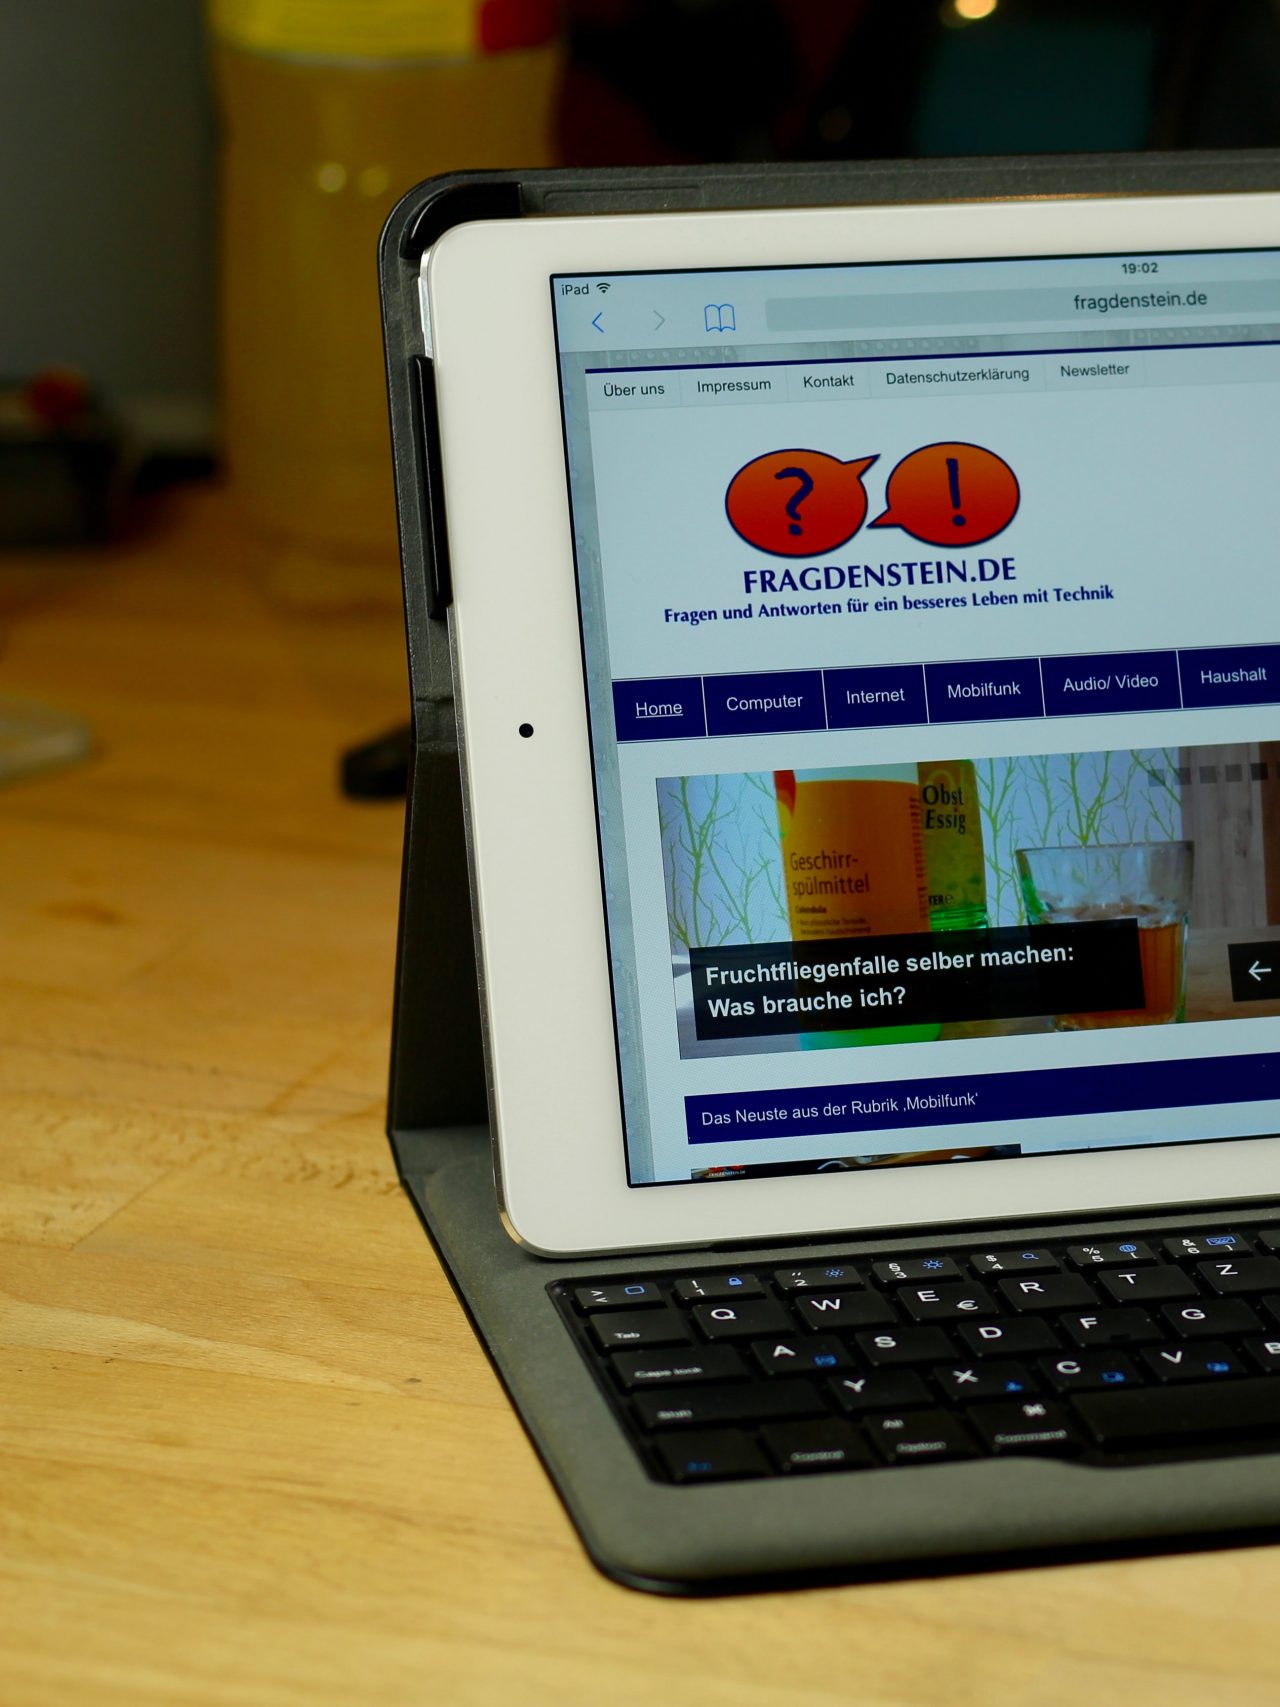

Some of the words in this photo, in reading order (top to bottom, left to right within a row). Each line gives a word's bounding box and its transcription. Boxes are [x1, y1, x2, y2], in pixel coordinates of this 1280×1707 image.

[1122, 263, 1158, 274] 19:02
[561, 283, 589, 296] iPad
[1074, 291, 1208, 313] fragdenstein.de
[885, 366, 1030, 386] Datenschutzerklärung
[1060, 364, 1130, 377] Newsletter
[697, 378, 772, 396] Impressum
[803, 374, 855, 388] Kontakt
[603, 382, 635, 397] Über
[640, 384, 665, 396] uns
[743, 557, 1017, 594] FRAGDENSTEIN.DE
[664, 606, 718, 626] Fragen
[722, 603, 754, 620] und
[758, 600, 842, 618] Antworten
[847, 597, 871, 614] für
[875, 596, 898, 612] ein
[903, 592, 967, 611] besseres
[972, 590, 1019, 607] Leben
[1023, 588, 1049, 604] mit
[1054, 585, 1114, 602] Technik
[1063, 676, 1111, 692] Audio/
[1115, 674, 1159, 689] Video
[1200, 667, 1267, 685] Haushalt
[846, 688, 905, 705] Internet
[947, 681, 1021, 699] Mobilfunk
[636, 702, 683, 718] Home
[726, 694, 803, 712] Computer
[923, 783, 964, 805] Obst
[925, 807, 965, 835] Essig
[791, 850, 858, 871] Geschirr-
[793, 873, 869, 899] spülmittel
[706, 955, 900, 986] Fruchtfliegenfalle
[905, 951, 975, 973] selber
[980, 945, 1075, 968] machen:
[708, 998, 756, 1018] Was
[763, 990, 853, 1014] brauche
[860, 986, 907, 1008] ich?
[701, 1110, 732, 1126] Das
[735, 1106, 788, 1123] Neuste
[792, 1106, 819, 1119] aus
[823, 1101, 847, 1117] der
[851, 1097, 899, 1114] Rubrik
[1216, 1264, 1238, 1276] Z
[1118, 1273, 1136, 1285] T
[1019, 1281, 1044, 1293] R
[917, 1290, 939, 1302] E
[811, 1299, 841, 1311] W
[956, 1300, 978, 1311] €
[711, 1308, 737, 1321] Q
[1181, 1308, 1206, 1320] G
[1079, 1317, 1098, 1329] F
[978, 1327, 1002, 1339] D
[874, 1336, 896, 1348] S
[773, 1345, 796, 1357] A
[1161, 1350, 1182, 1364] V
[1056, 1361, 1081, 1374] C
[953, 1369, 979, 1383] X
[843, 1379, 866, 1393] Y
